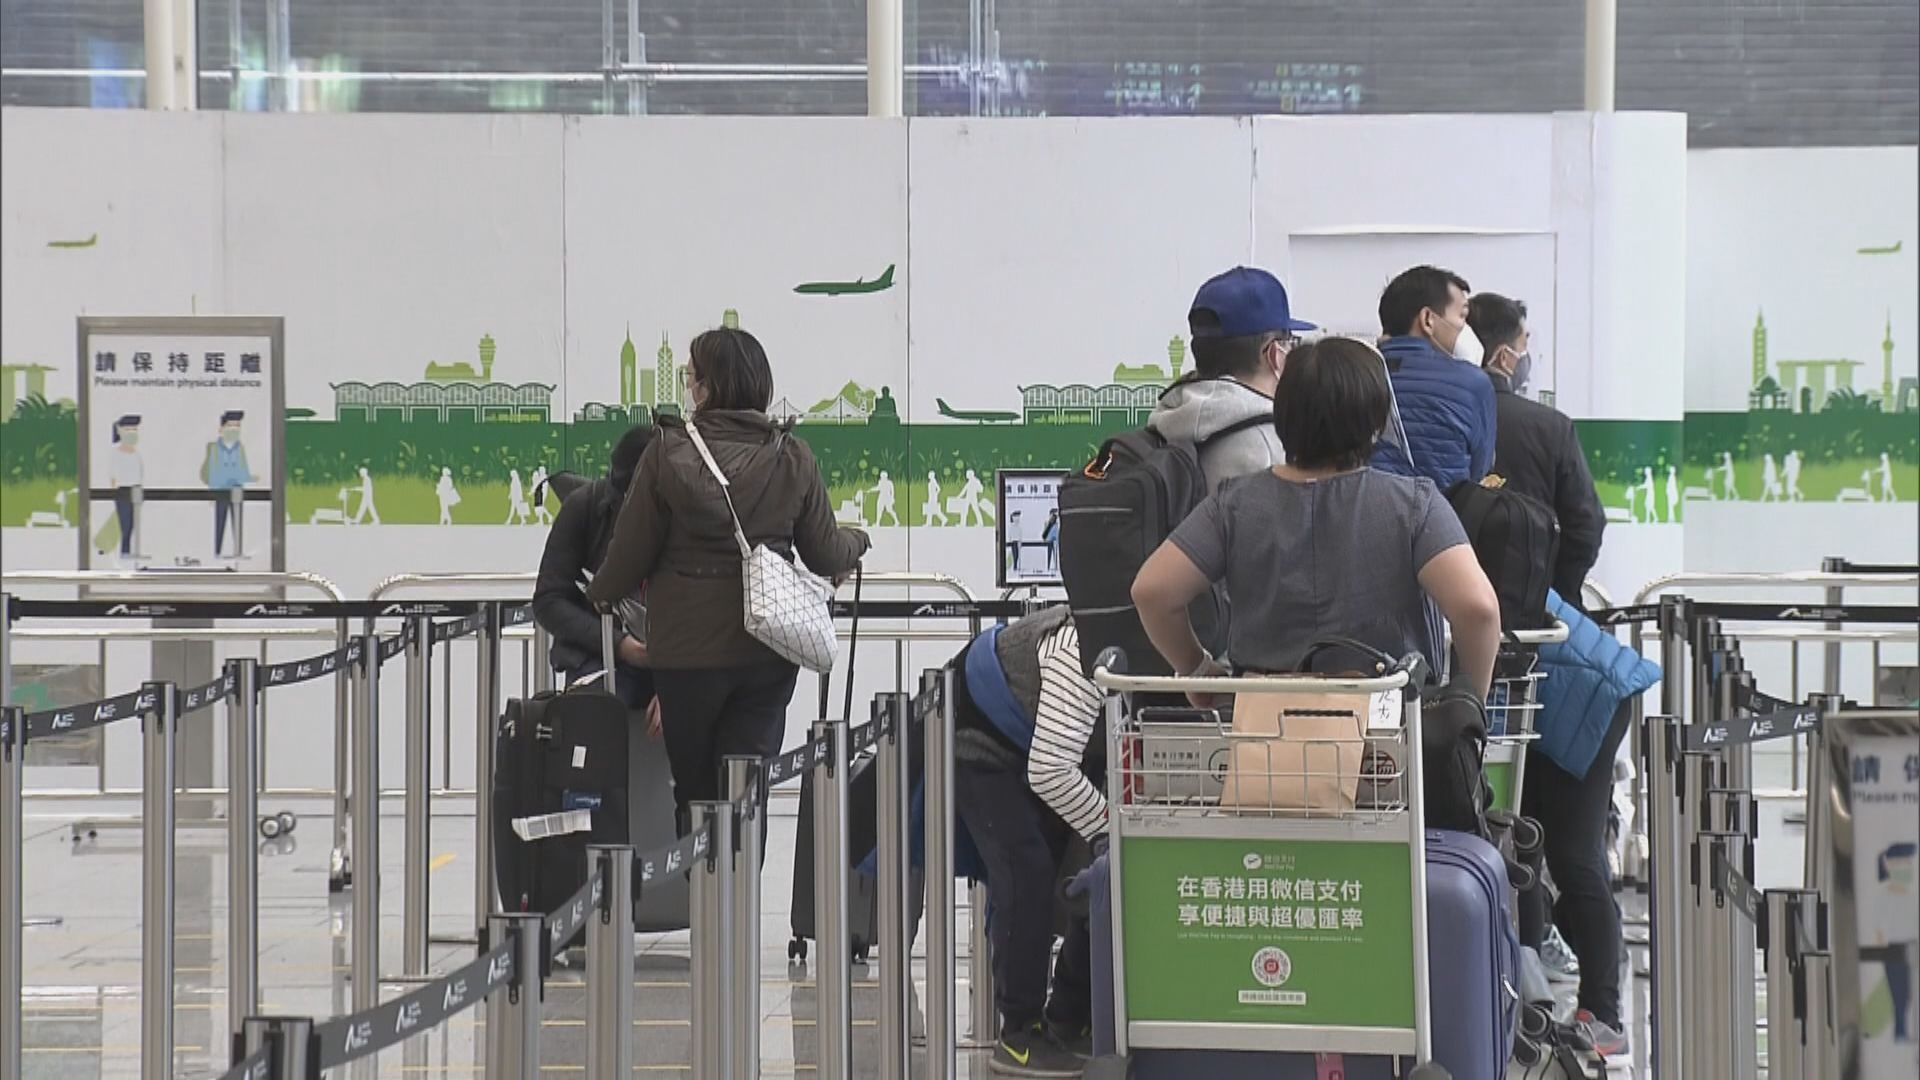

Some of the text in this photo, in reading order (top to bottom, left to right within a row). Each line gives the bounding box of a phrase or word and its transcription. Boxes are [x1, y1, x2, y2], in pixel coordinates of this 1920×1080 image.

[95, 351, 261, 373] 請保持距離
[94, 376, 128, 388] Please
[1177, 875, 1363, 901] 在香港用微信支付
[1178, 904, 1364, 930] 享便捷與超優匯率
